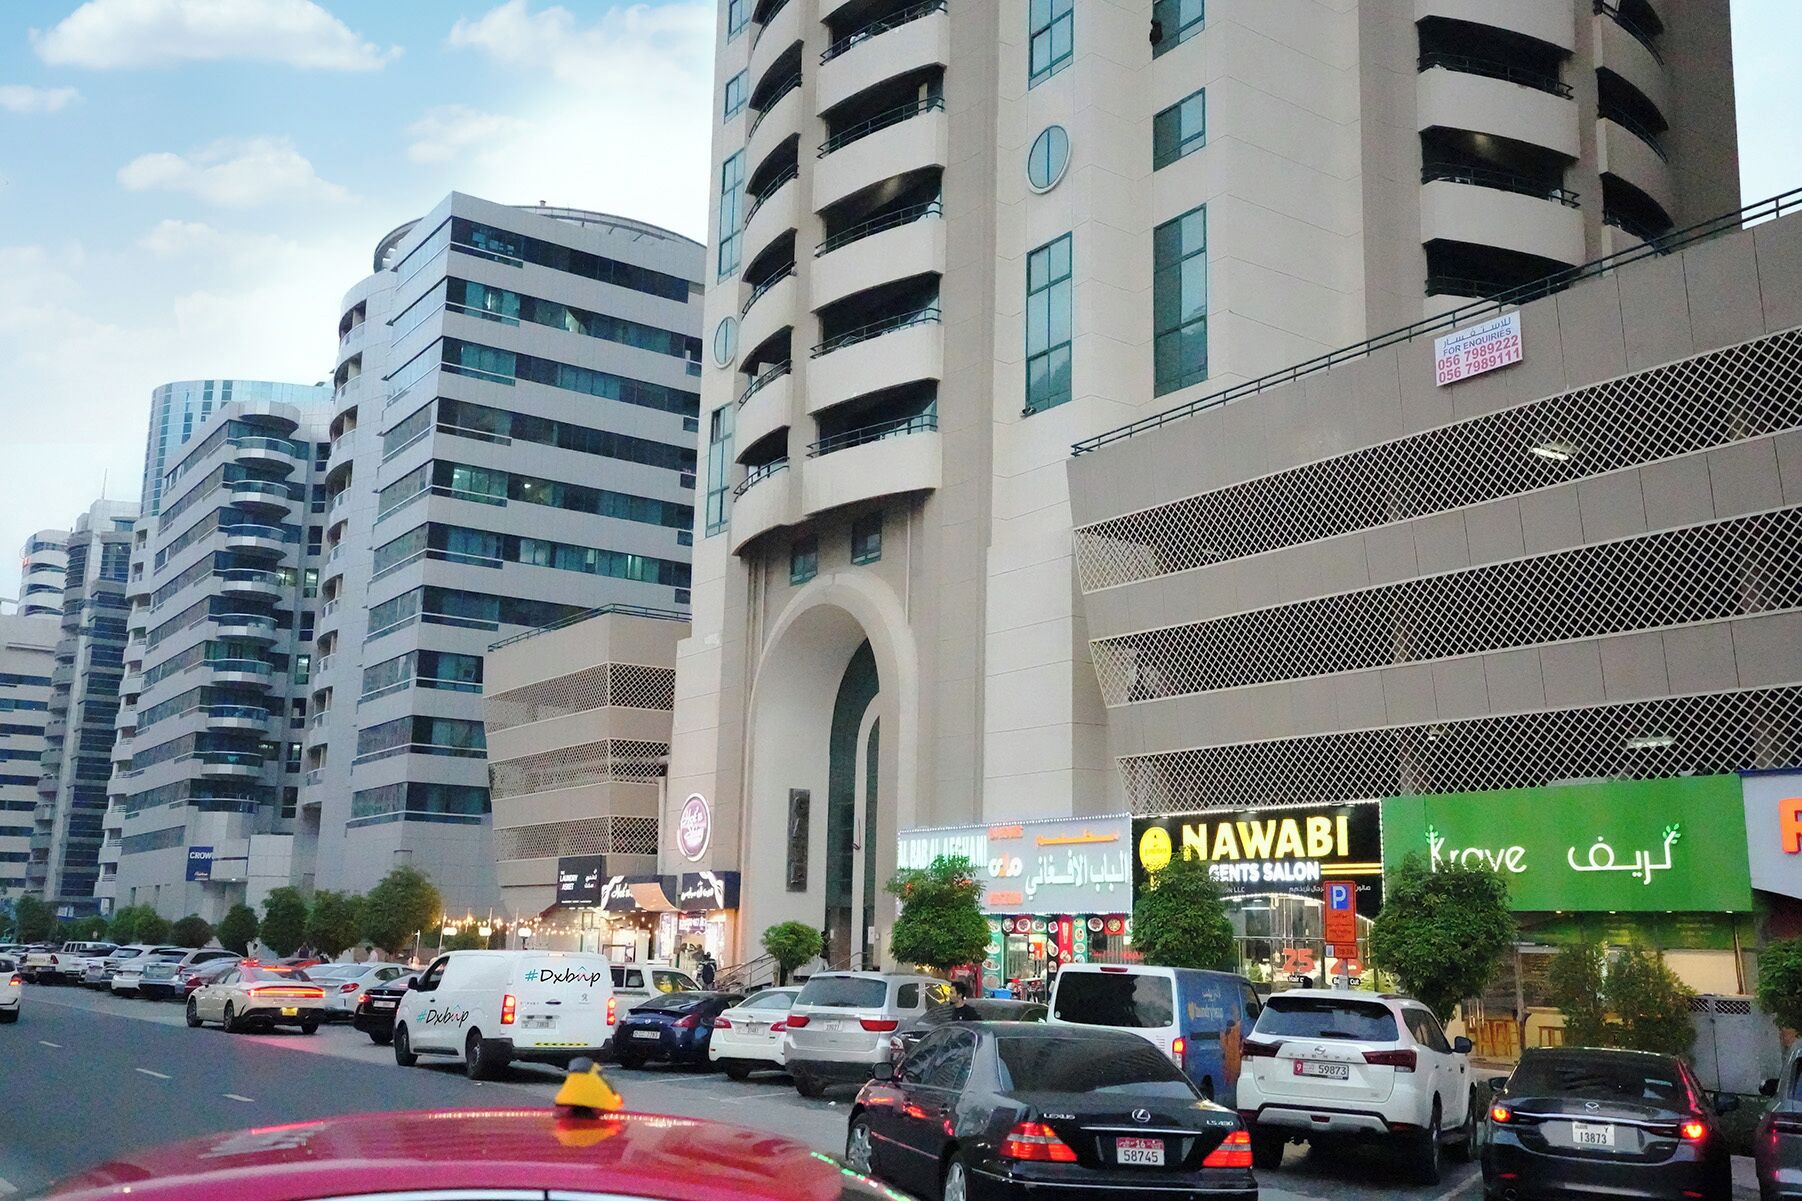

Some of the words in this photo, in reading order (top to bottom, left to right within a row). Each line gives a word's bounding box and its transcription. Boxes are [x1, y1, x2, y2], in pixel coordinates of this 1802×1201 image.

[1438, 354, 1460, 371] 056
[1464, 334, 1519, 362] 7989222
[1443, 345, 1461, 356] FOR
[1463, 327, 1512, 350] ENQUIRIES
[1439, 367, 1461, 383] 056
[1465, 347, 1520, 374] 7989111
[1182, 815, 1349, 862] NAWABI
[1427, 829, 1528, 873] Krave
[1089, 849, 1129, 892] الباب
[1208, 862, 1260, 882] GENTS
[1262, 860, 1320, 882] SALON
[1567, 831, 1680, 885] كريف
[1318, 1065, 1347, 1075] 59873
[1135, 1140, 1146, 1148] 16
[1579, 1131, 1608, 1144] 13873
[1123, 1150, 1159, 1162] 58745
